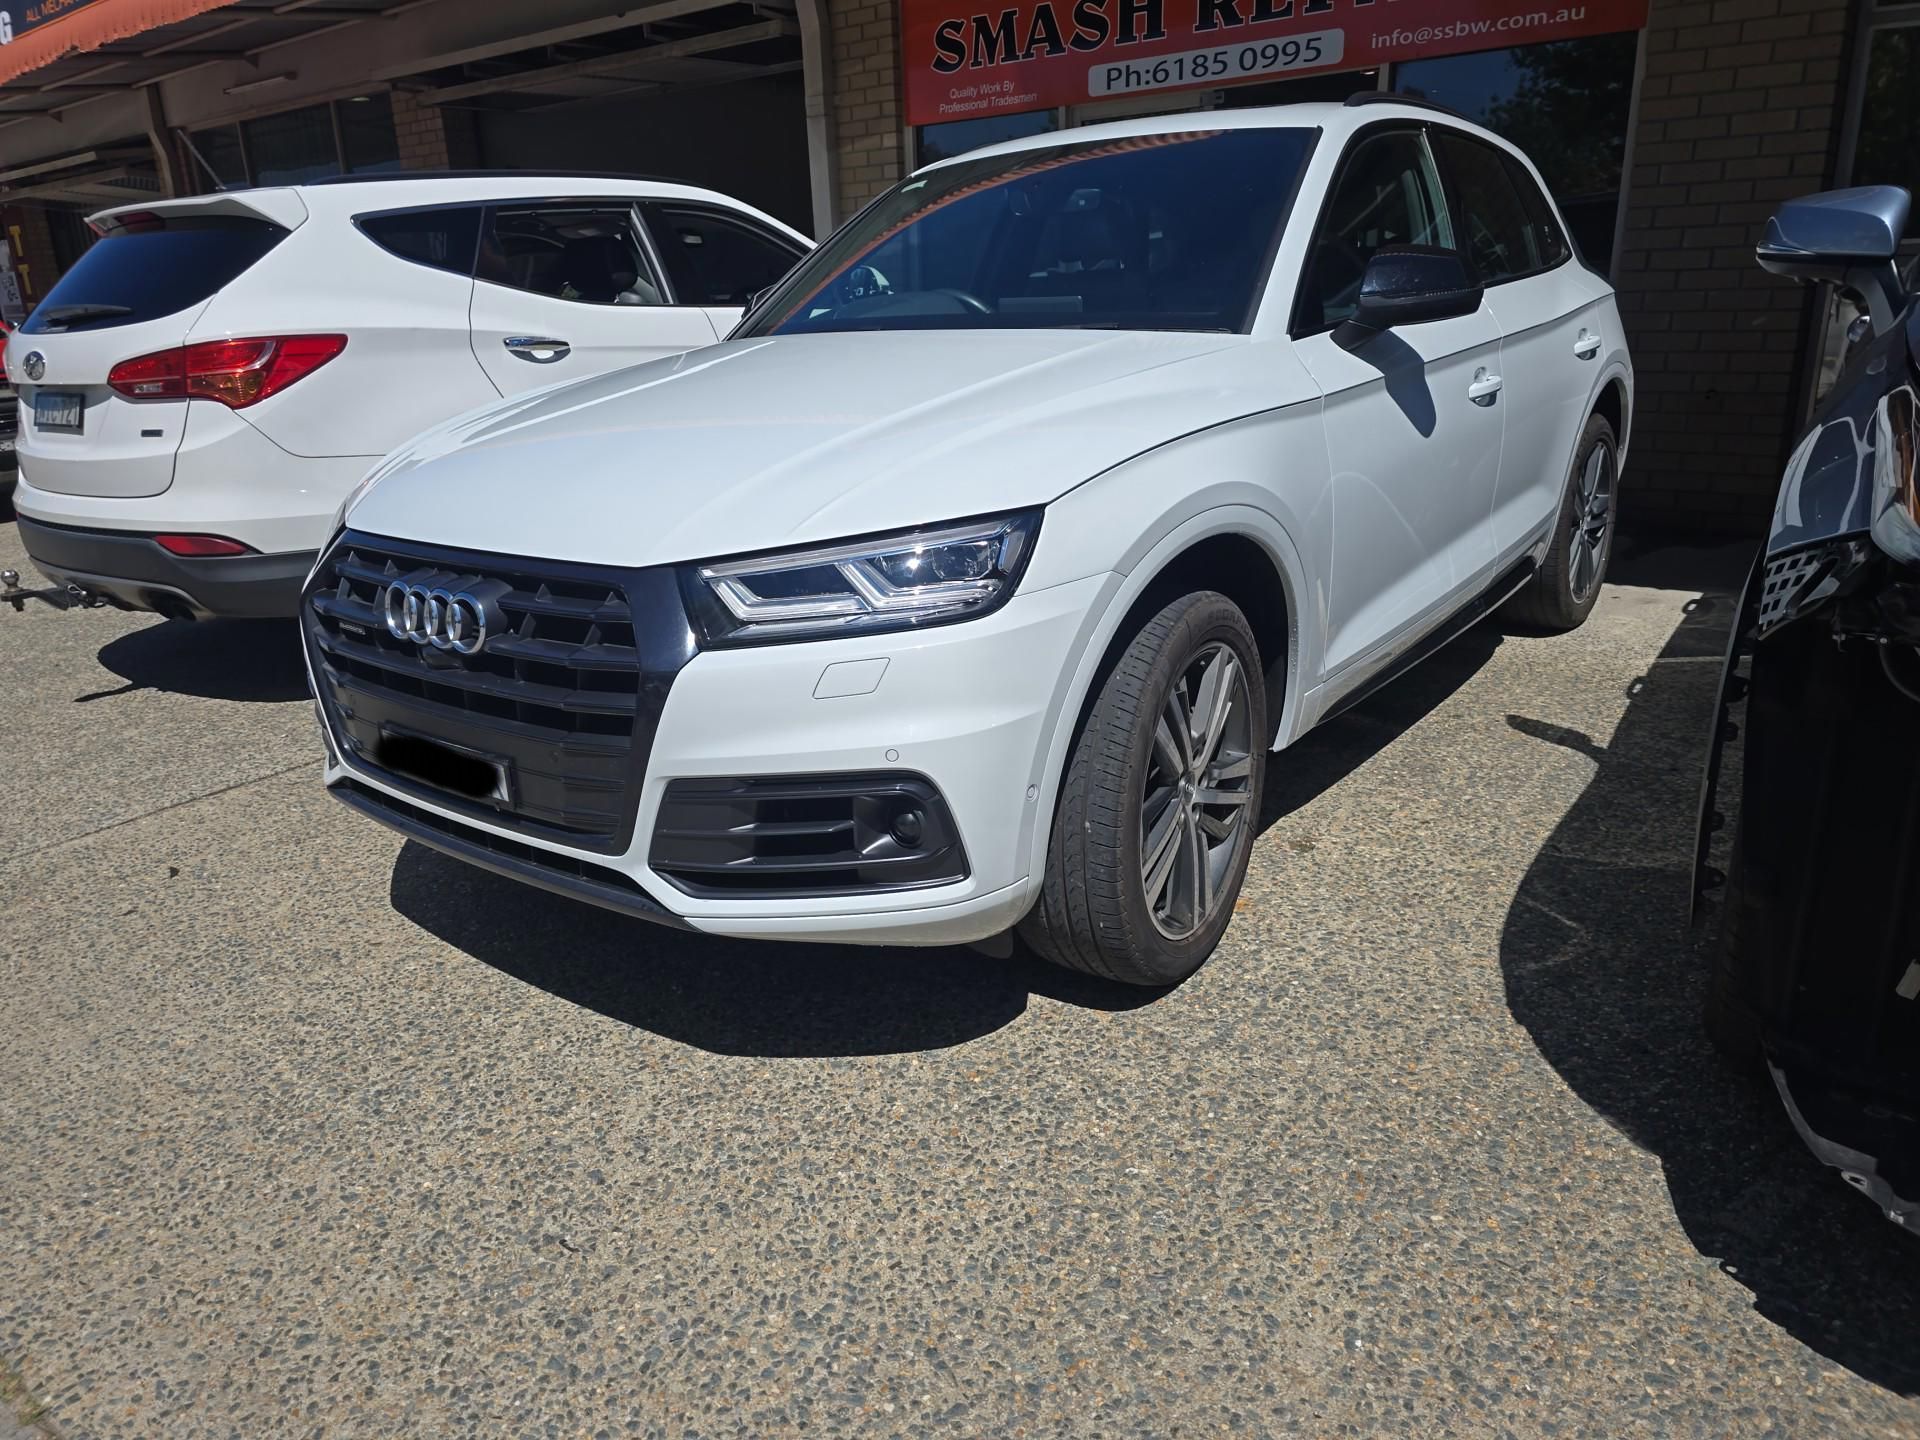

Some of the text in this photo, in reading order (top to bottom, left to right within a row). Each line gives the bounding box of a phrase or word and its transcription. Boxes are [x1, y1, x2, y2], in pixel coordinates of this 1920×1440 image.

[930, 0, 1167, 74] SMASH
[1371, 6, 1586, 49] info@ssbw.com.au
[1106, 37, 1323, 91] Ph:6185 0995
[939, 98, 989, 114] Professional
[949, 80, 1015, 99] Quality Work By
